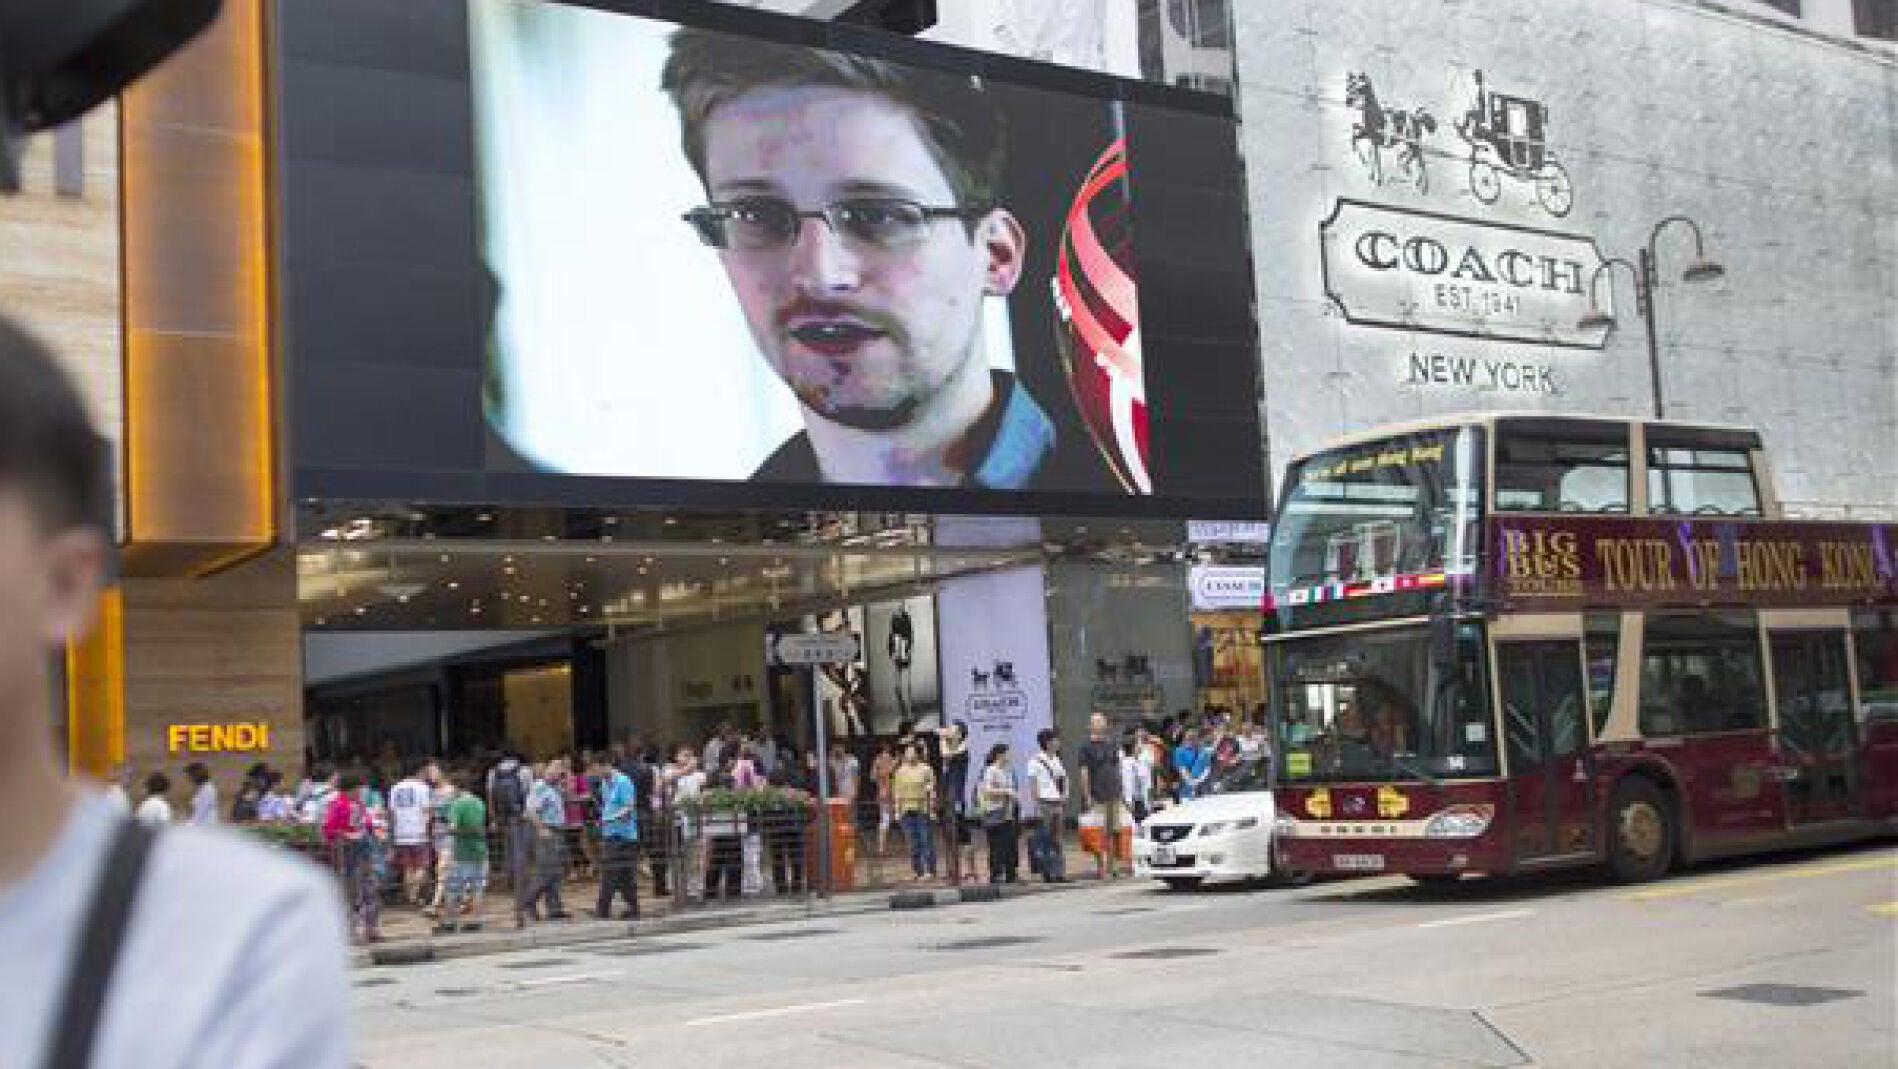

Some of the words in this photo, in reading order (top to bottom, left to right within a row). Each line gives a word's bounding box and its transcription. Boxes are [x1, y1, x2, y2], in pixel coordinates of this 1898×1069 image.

[1355, 230, 1586, 294] COACH
[1408, 352, 1477, 386] NEW
[1483, 358, 1557, 394] YORK
[1504, 529, 1576, 553] BIG
[1508, 553, 1582, 578] BUS
[1595, 538, 1676, 591] TOUR
[1684, 538, 1719, 591] OF
[1733, 540, 1808, 591] HONG
[167, 721, 269, 752] FENDI
